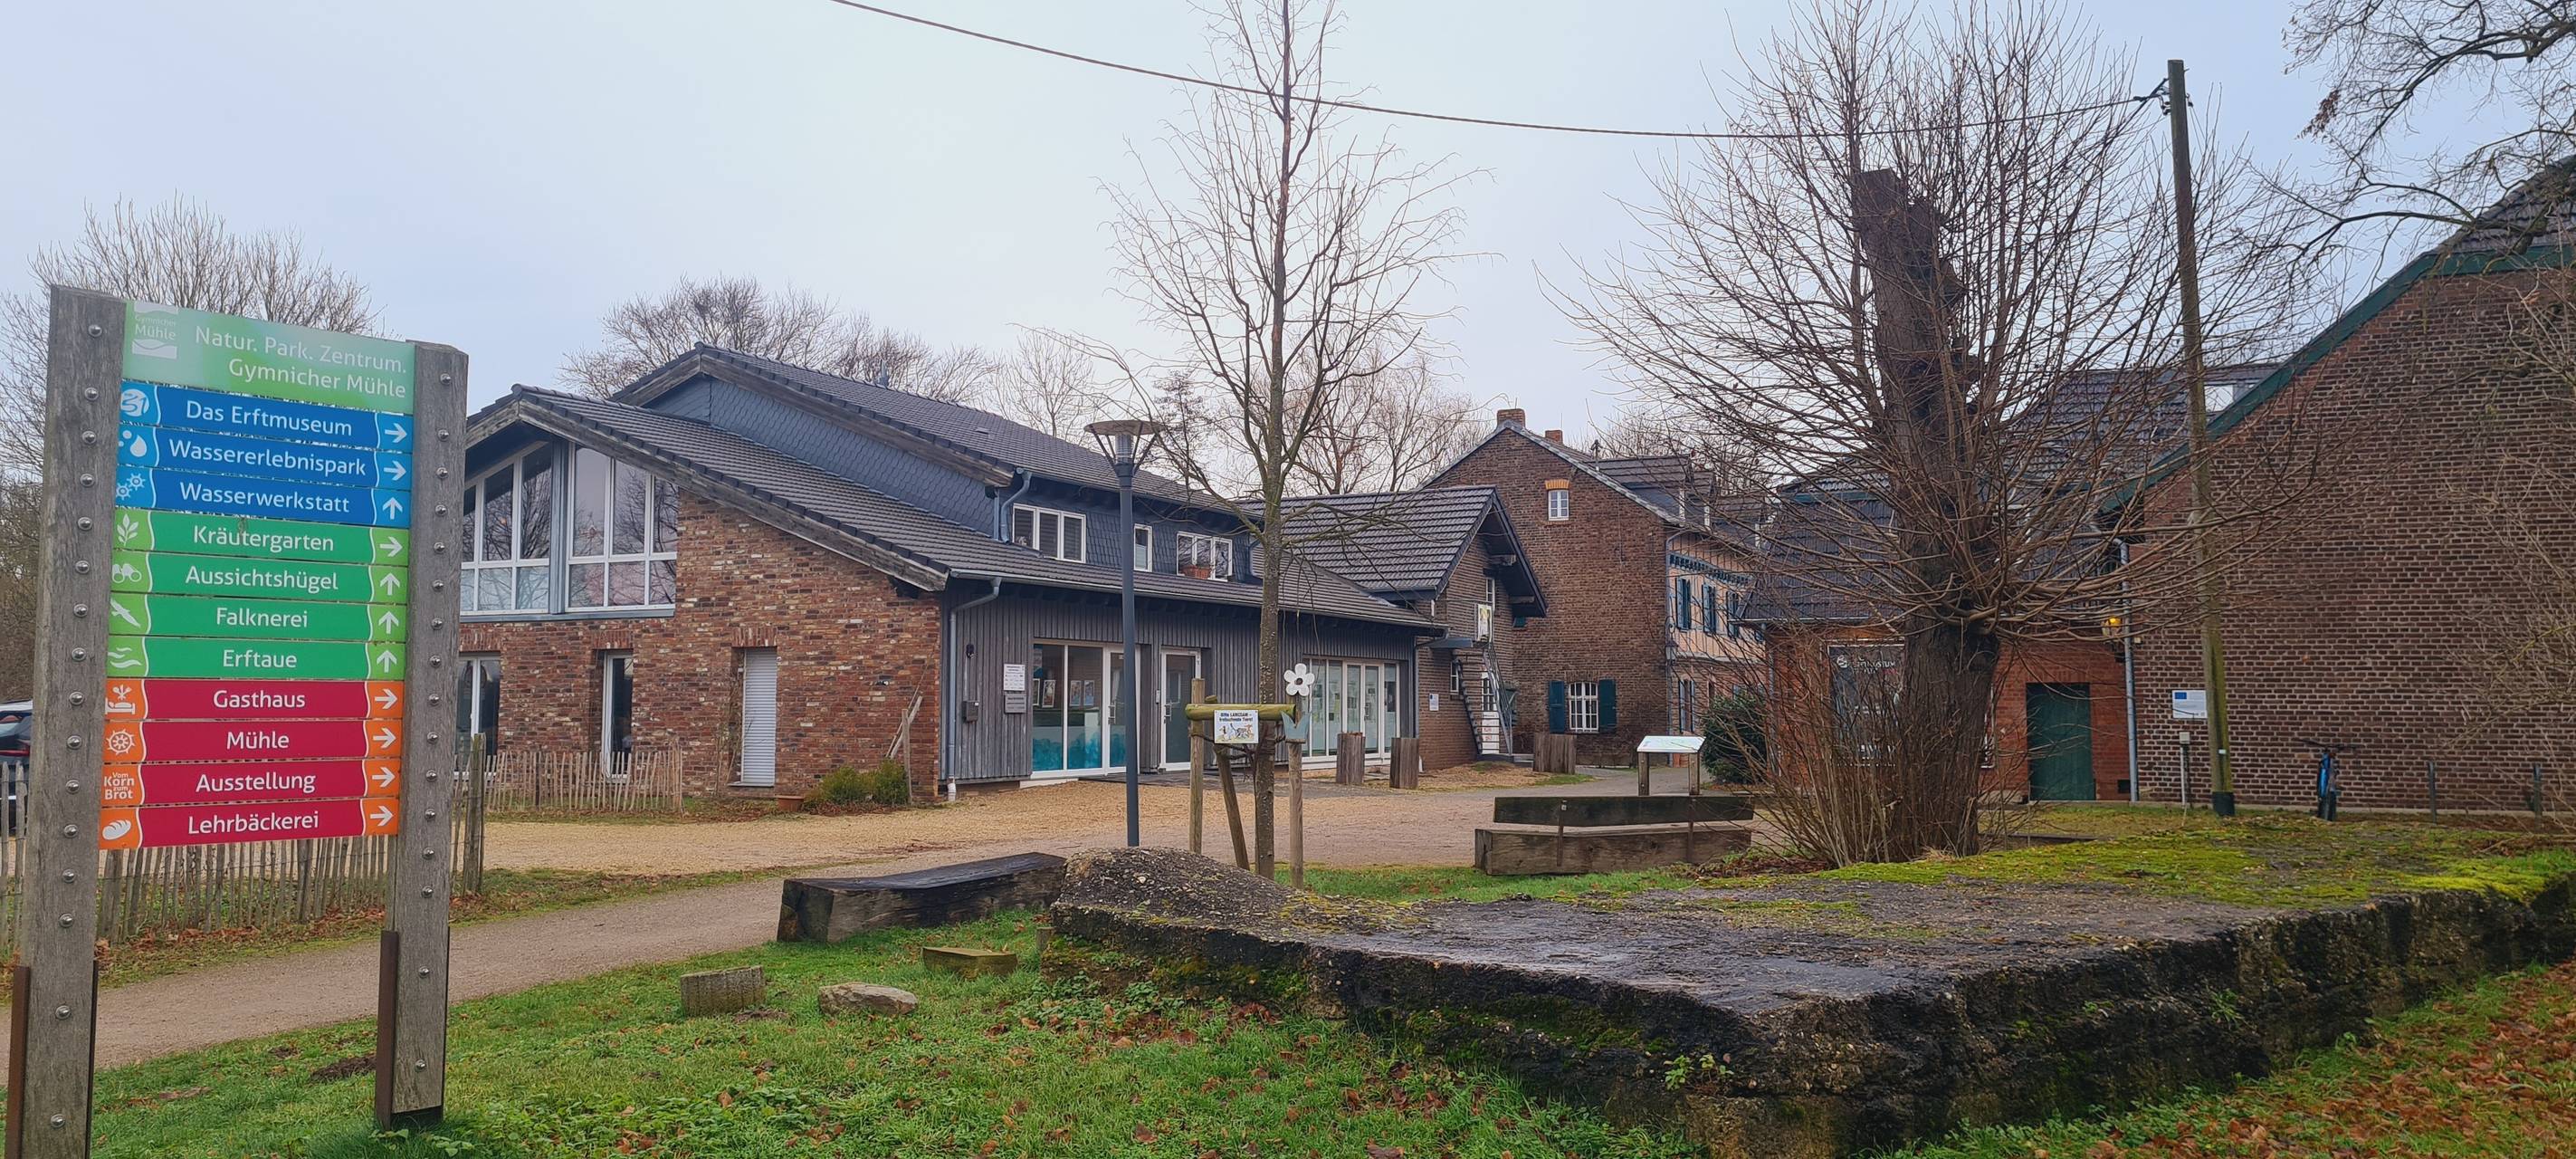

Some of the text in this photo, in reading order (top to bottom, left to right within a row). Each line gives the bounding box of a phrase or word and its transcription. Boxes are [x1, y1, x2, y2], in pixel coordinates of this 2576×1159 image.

[135, 324, 176, 340] Mühle
[196, 325, 407, 373] Natur. Park. Zentrum.
[229, 359, 406, 398] Gymnicher Mühle
[186, 400, 353, 436] Das Erftmuseum
[168, 439, 367, 477] Wassererlebnispark
[179, 482, 350, 513] Wasserwerkstatt
[194, 525, 335, 554] Kräutergarten
[185, 565, 339, 594] Aussichtshügel
[216, 607, 308, 627] Falknerei
[223, 649, 298, 668] Erftaue
[213, 689, 306, 709] Gasthaus
[226, 731, 290, 750] Mühle
[104, 776, 135, 787] Korn
[196, 771, 316, 793] Ausstellung
[105, 789, 133, 800] Brot
[188, 811, 320, 835] Lehrbäckerei
